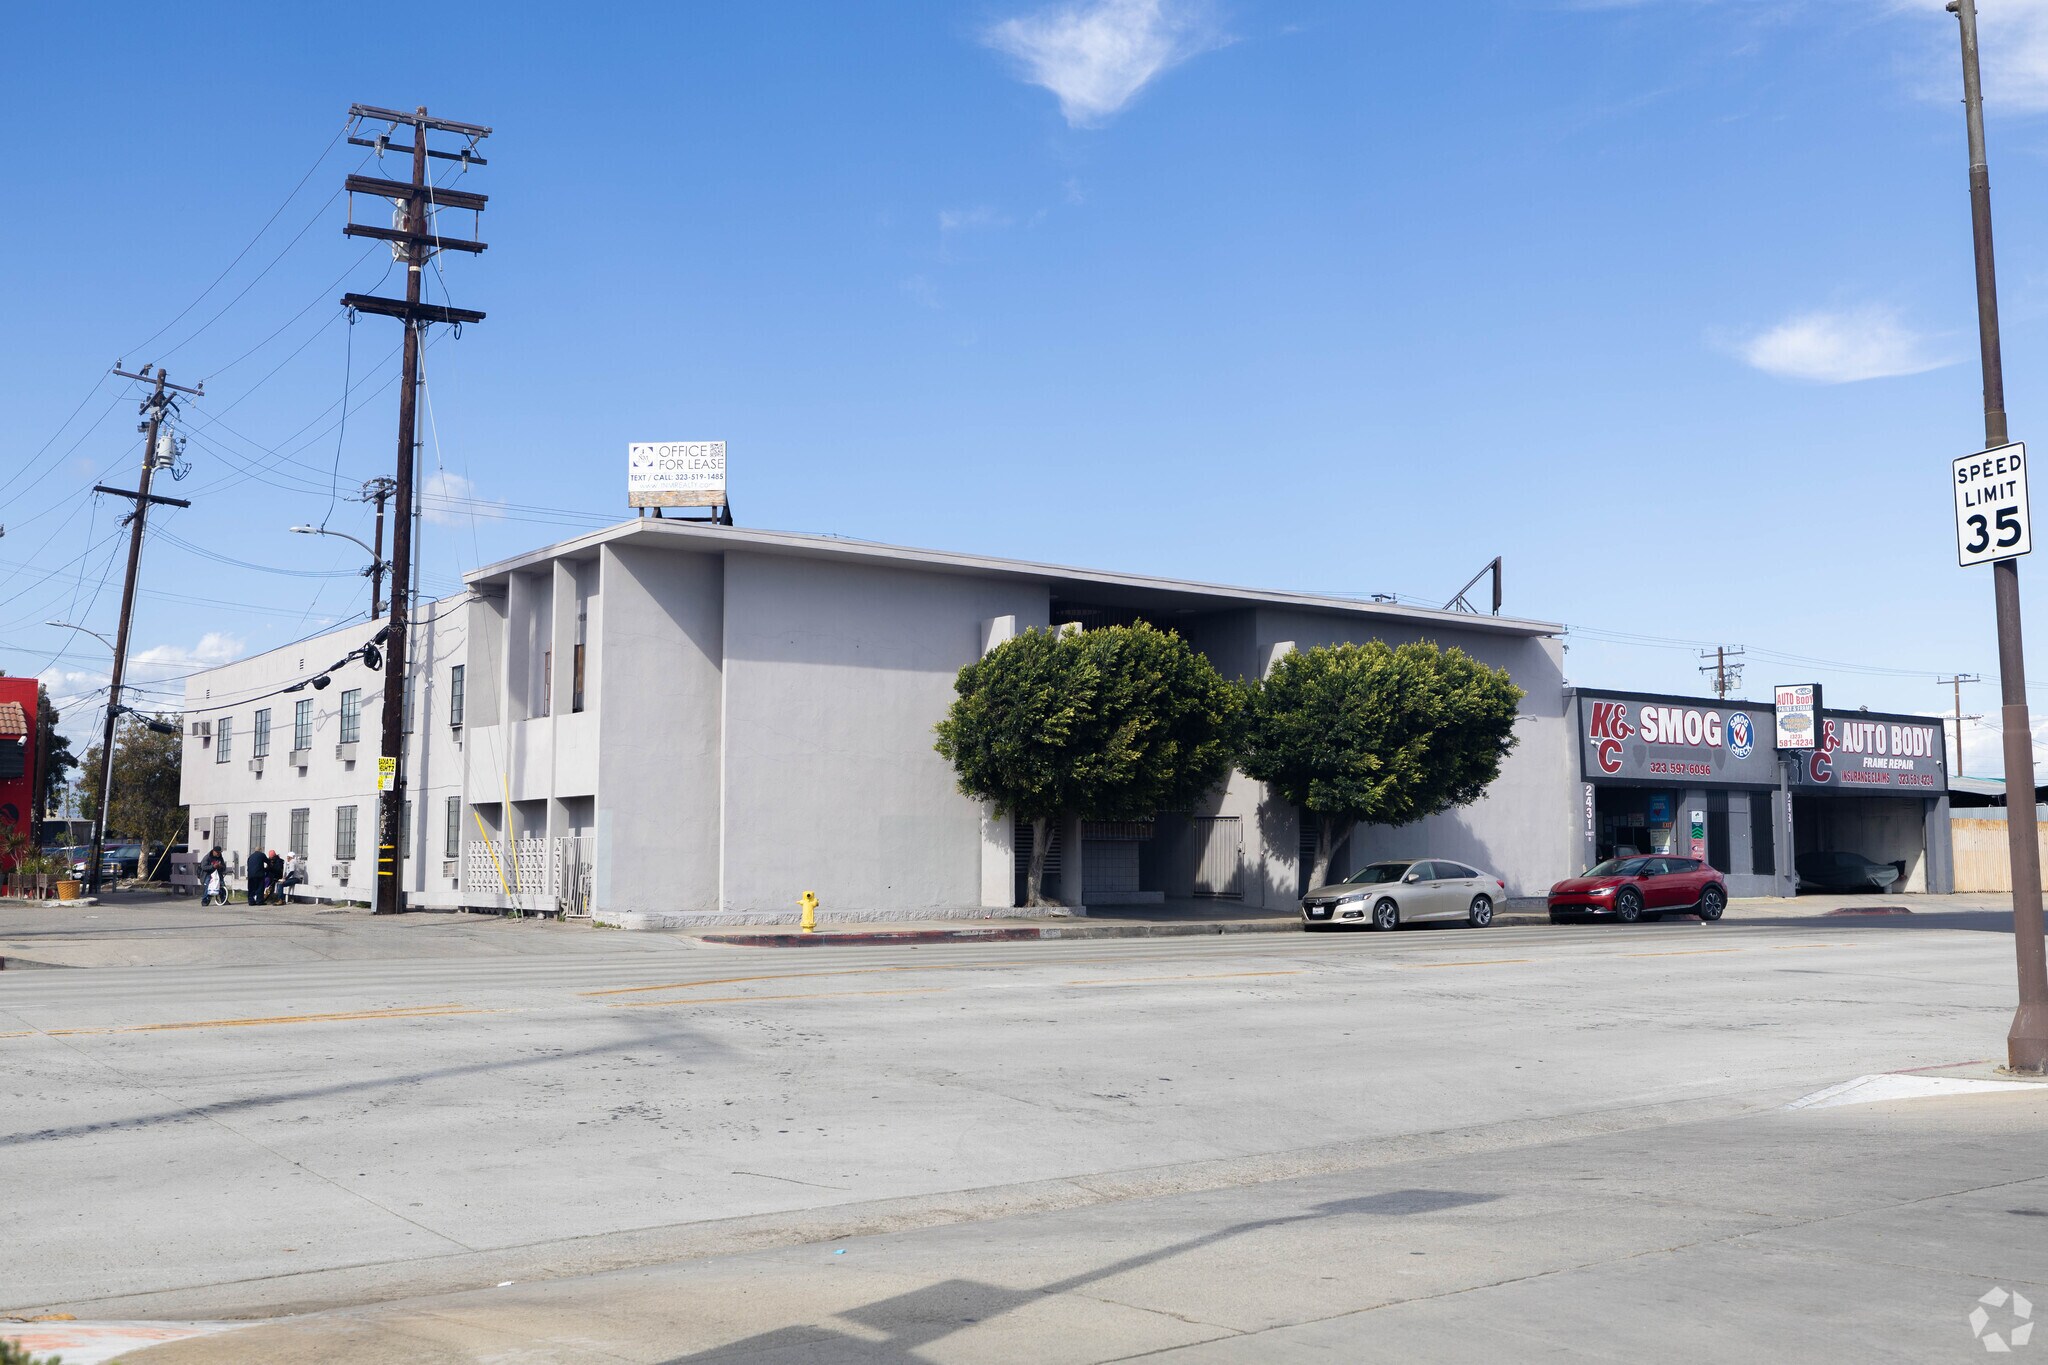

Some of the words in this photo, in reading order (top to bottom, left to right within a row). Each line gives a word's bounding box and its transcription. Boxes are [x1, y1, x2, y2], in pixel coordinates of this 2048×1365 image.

[659, 445, 707, 457] OFFICE
[659, 459, 684, 470] FOR
[688, 458, 724, 470] LEASE
[1958, 454, 2021, 484] SPEED
[1965, 480, 2016, 507] LIMIT
[1966, 505, 2022, 554] 35
[1777, 693, 1794, 706] AUTO
[1795, 694, 1813, 705] BODY
[1640, 705, 1722, 747] SMOG
[1730, 715, 1749, 729] SMOG
[1731, 742, 1752, 757] CHECK
[1779, 739, 1813, 747] 581-4234
[1842, 722, 1887, 755] AUTO
[1890, 725, 1934, 758] BODY
[1598, 738, 1623, 774] C
[1863, 757, 1887, 769] FRAME
[1888, 758, 1914, 770] REPAIR
[1810, 751, 1833, 784] C
[1841, 770, 1871, 784] INSURANCE
[1871, 772, 1890, 785] CLAIMS
[1585, 785, 1593, 830] 2431
